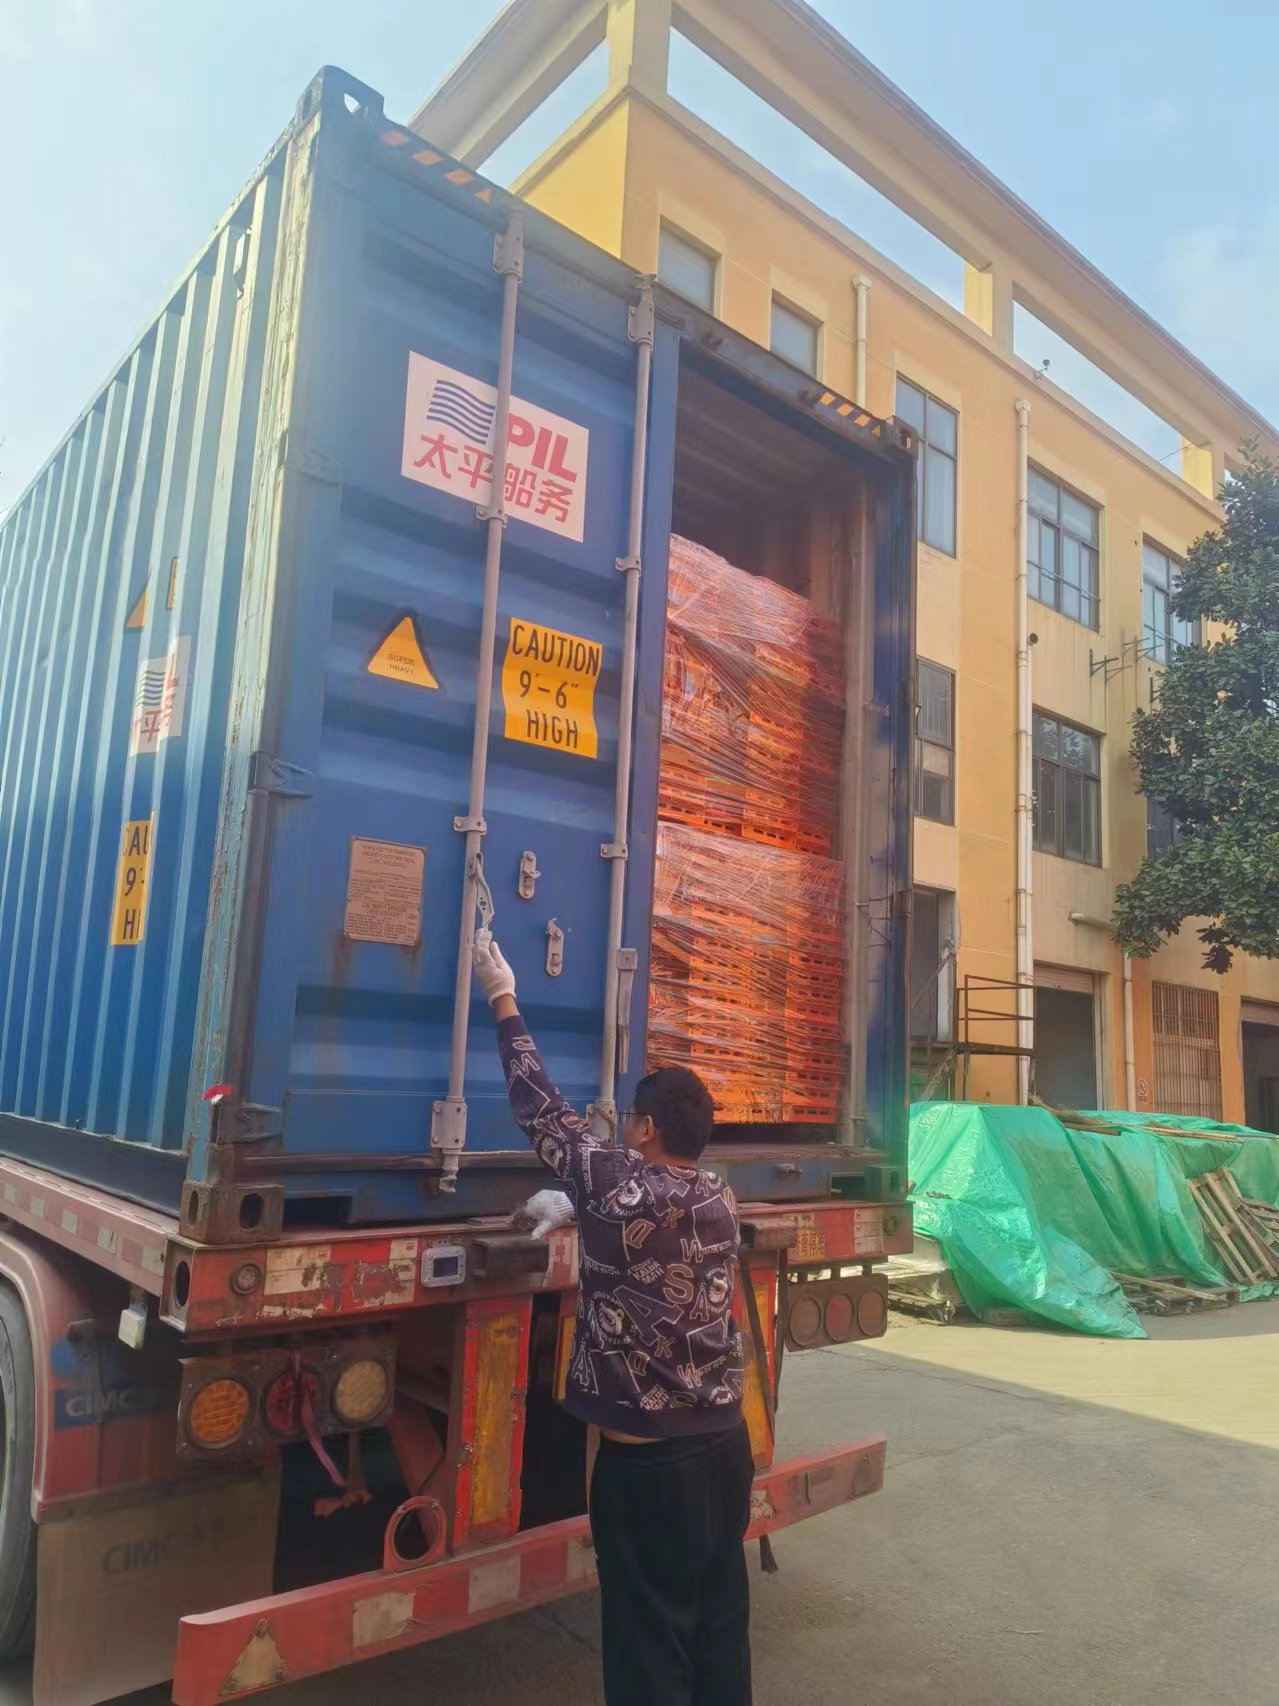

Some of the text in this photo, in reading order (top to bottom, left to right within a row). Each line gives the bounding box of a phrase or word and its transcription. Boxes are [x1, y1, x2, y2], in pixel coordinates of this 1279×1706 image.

[508, 412, 578, 483] PIL
[413, 433, 574, 523] 太平船务
[511, 624, 600, 677] CAUTION
[526, 708, 578, 749] HIGH
[662, 1263, 694, 1305] S
